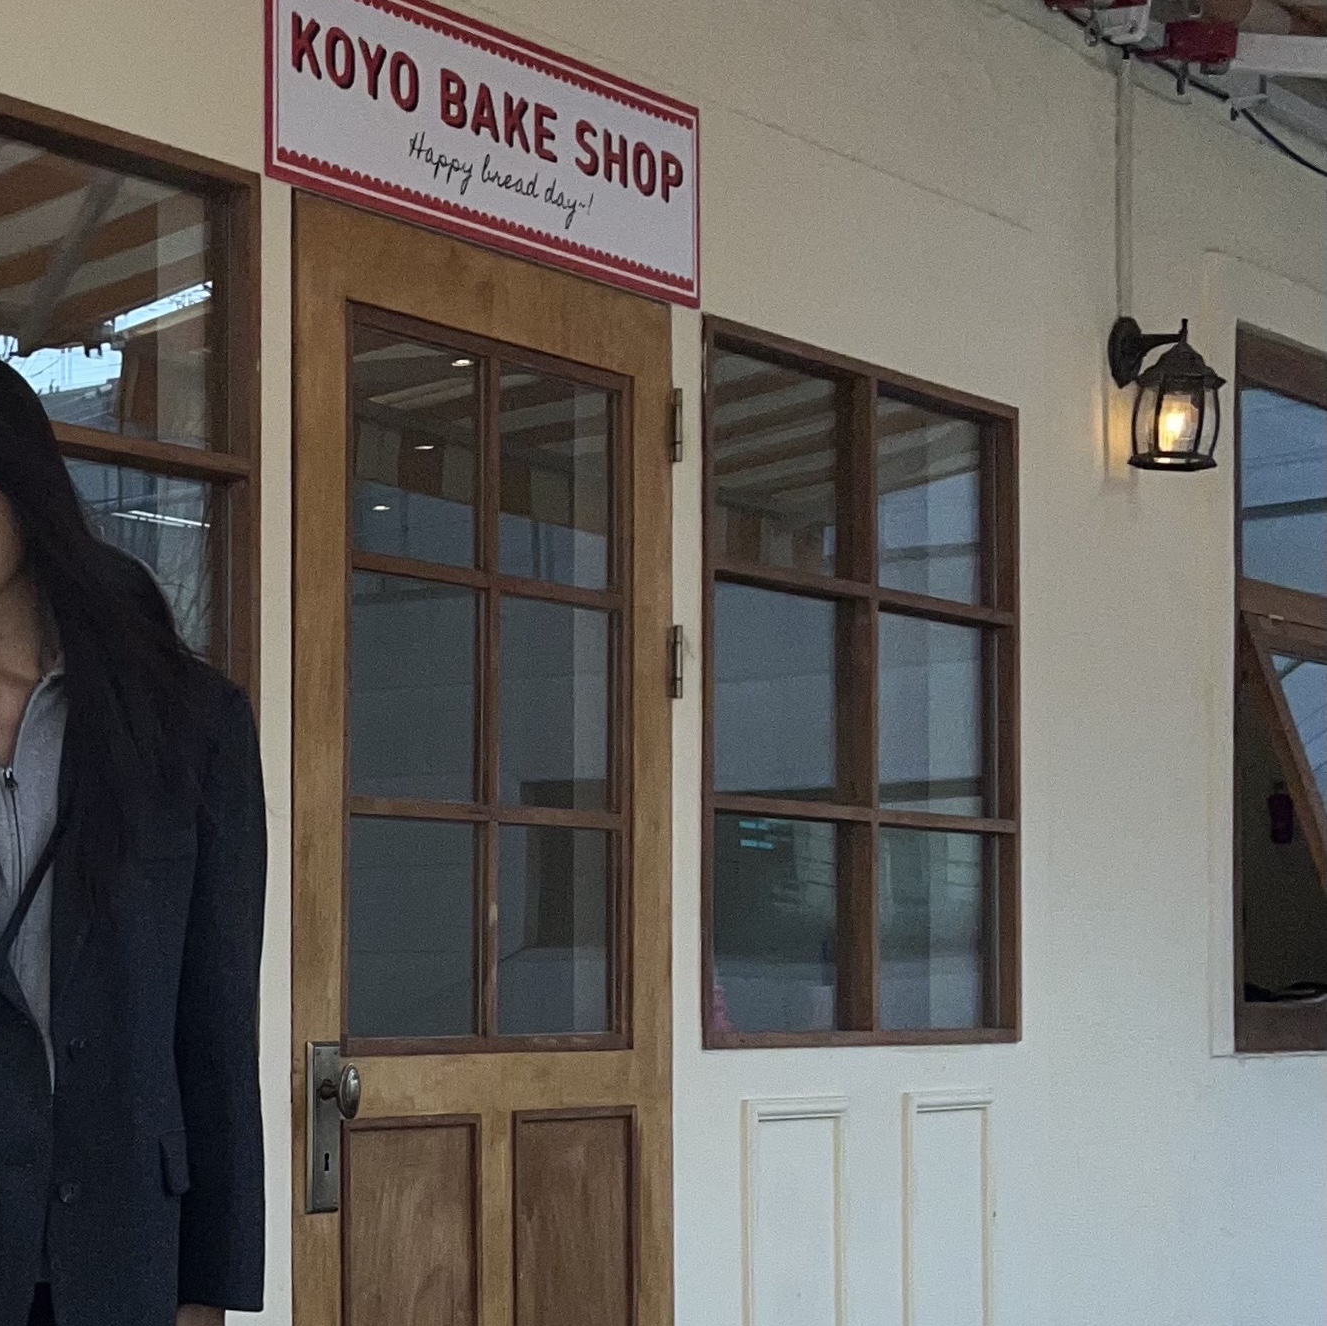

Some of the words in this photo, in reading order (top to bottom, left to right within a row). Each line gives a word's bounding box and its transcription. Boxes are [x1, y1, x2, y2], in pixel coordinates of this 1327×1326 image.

[291, 11, 419, 112] KOYO
[440, 68, 558, 163] BAKE
[575, 119, 684, 203] SHOP
[408, 131, 473, 195] Happy
[481, 153, 539, 199] bread
